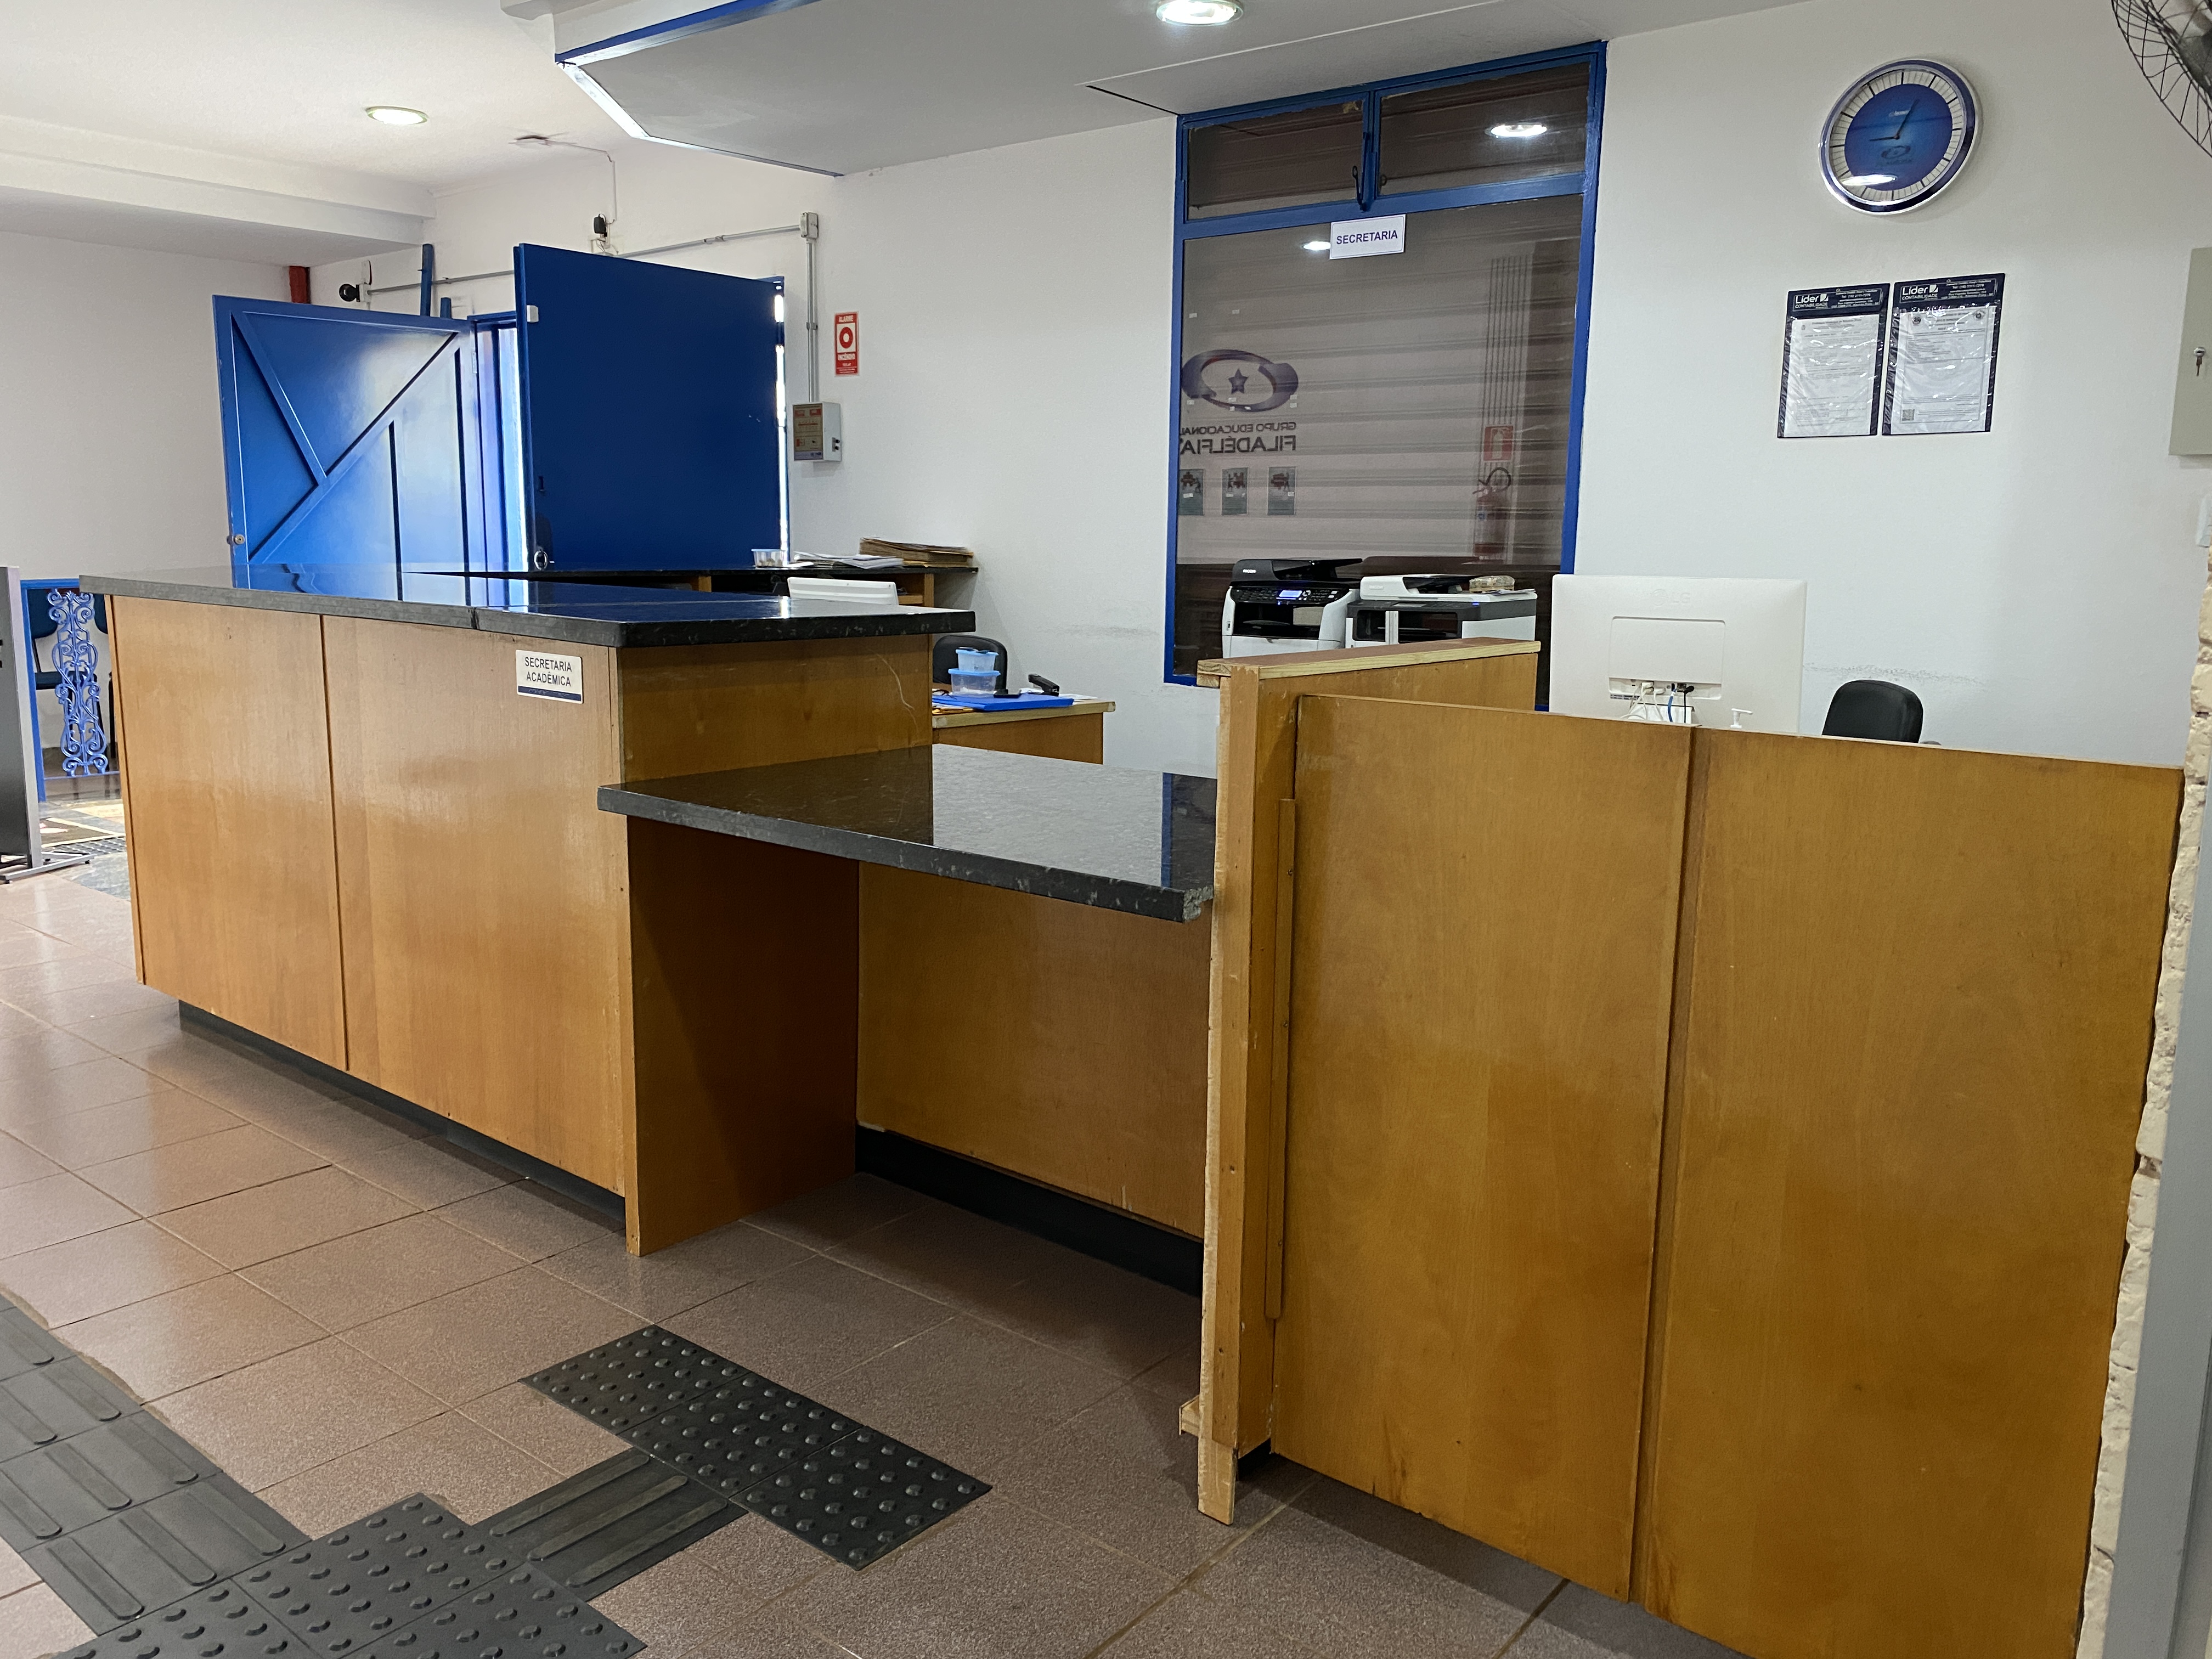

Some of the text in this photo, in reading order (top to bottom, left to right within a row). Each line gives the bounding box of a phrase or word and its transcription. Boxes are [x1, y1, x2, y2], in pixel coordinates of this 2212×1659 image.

[1336, 230, 1398, 245] SECRETARIA
[524, 657, 572, 672] SECRETARIA
[526, 671, 572, 687] ACADÊMICA
